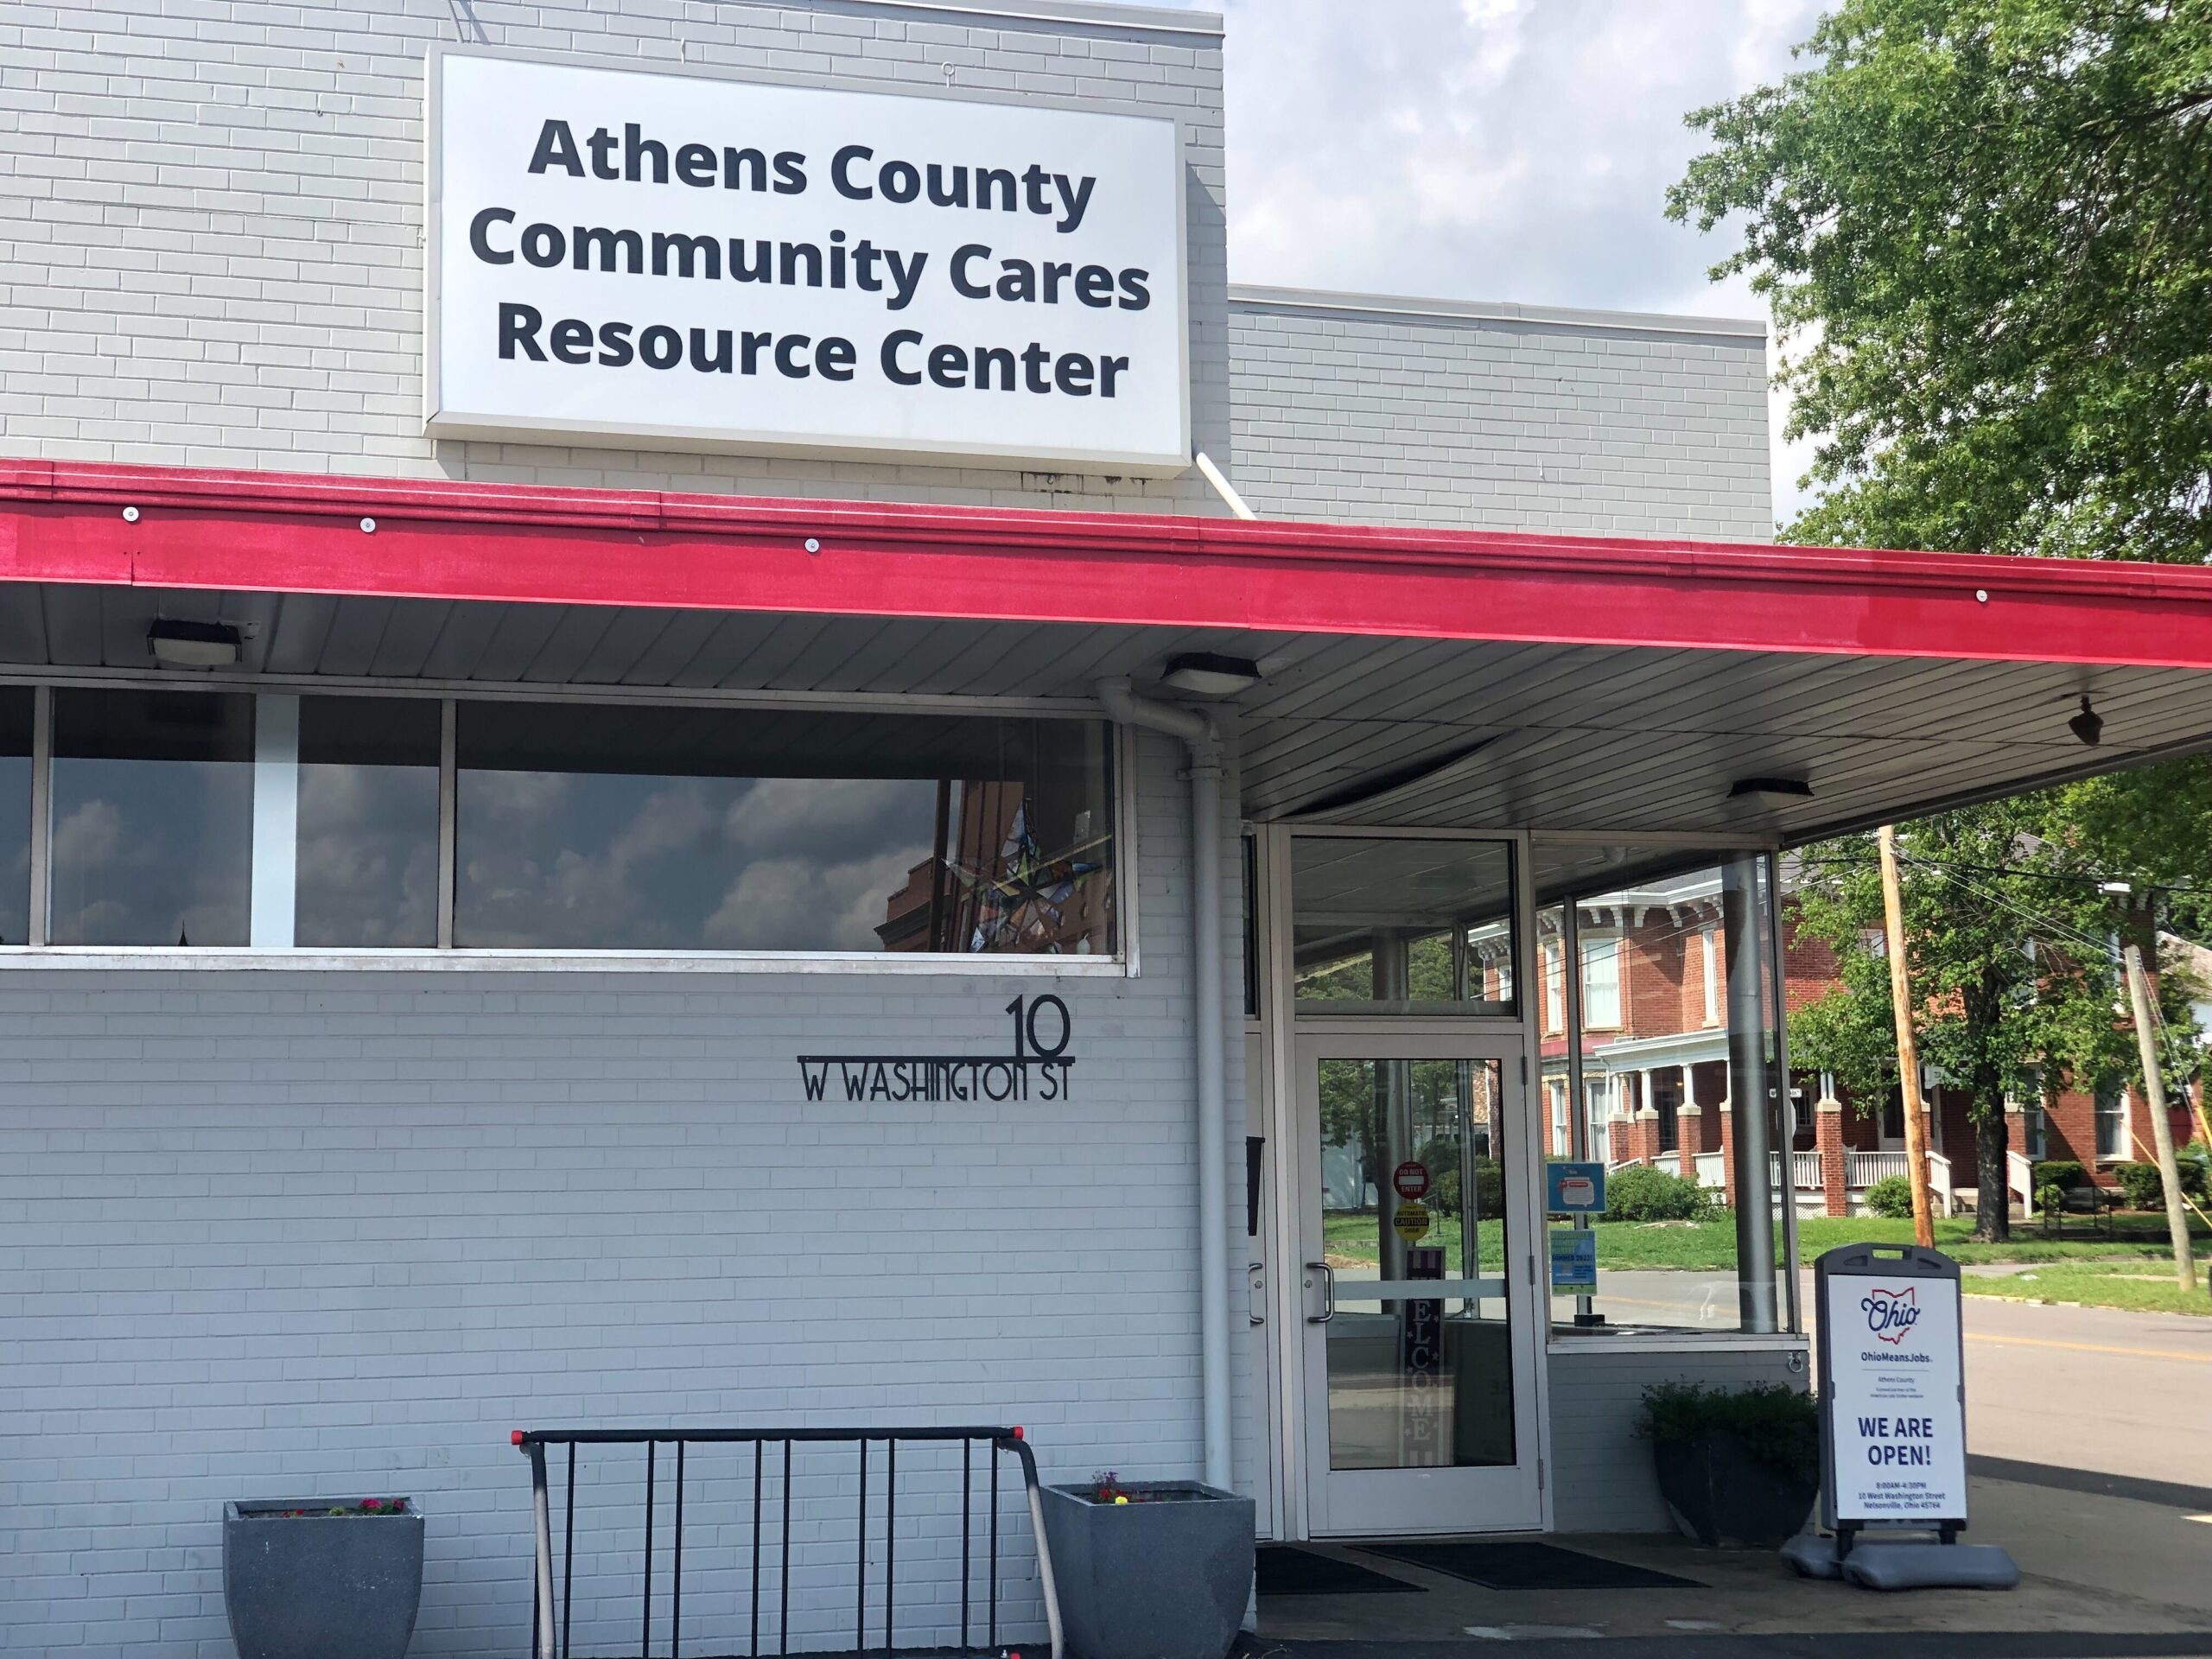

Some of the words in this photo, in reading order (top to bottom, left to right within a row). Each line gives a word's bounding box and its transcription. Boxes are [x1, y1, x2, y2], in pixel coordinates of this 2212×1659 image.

[528, 118, 808, 195] Athens
[830, 145, 1097, 233] County
[469, 207, 930, 310] Community
[950, 244, 1152, 311] Cares
[498, 302, 857, 382] Resource
[879, 329, 1129, 398] Center
[1005, 994, 1071, 1057] 10
[800, 1060, 828, 1101] W
[842, 1060, 1028, 1101] WASHINGTON
[1039, 1060, 1072, 1101] ST
[1861, 1298, 1921, 1332] Ohio
[1411, 1277, 1434, 1440] ELCOME
[1861, 1352, 1930, 1363] OhioMeansJobs
[1858, 1417, 1889, 1437] WE
[1894, 1418, 1933, 1438] ARE
[1868, 1445, 1931, 1465] OPEN!
[1885, 1492, 1923, 1501] Washington
